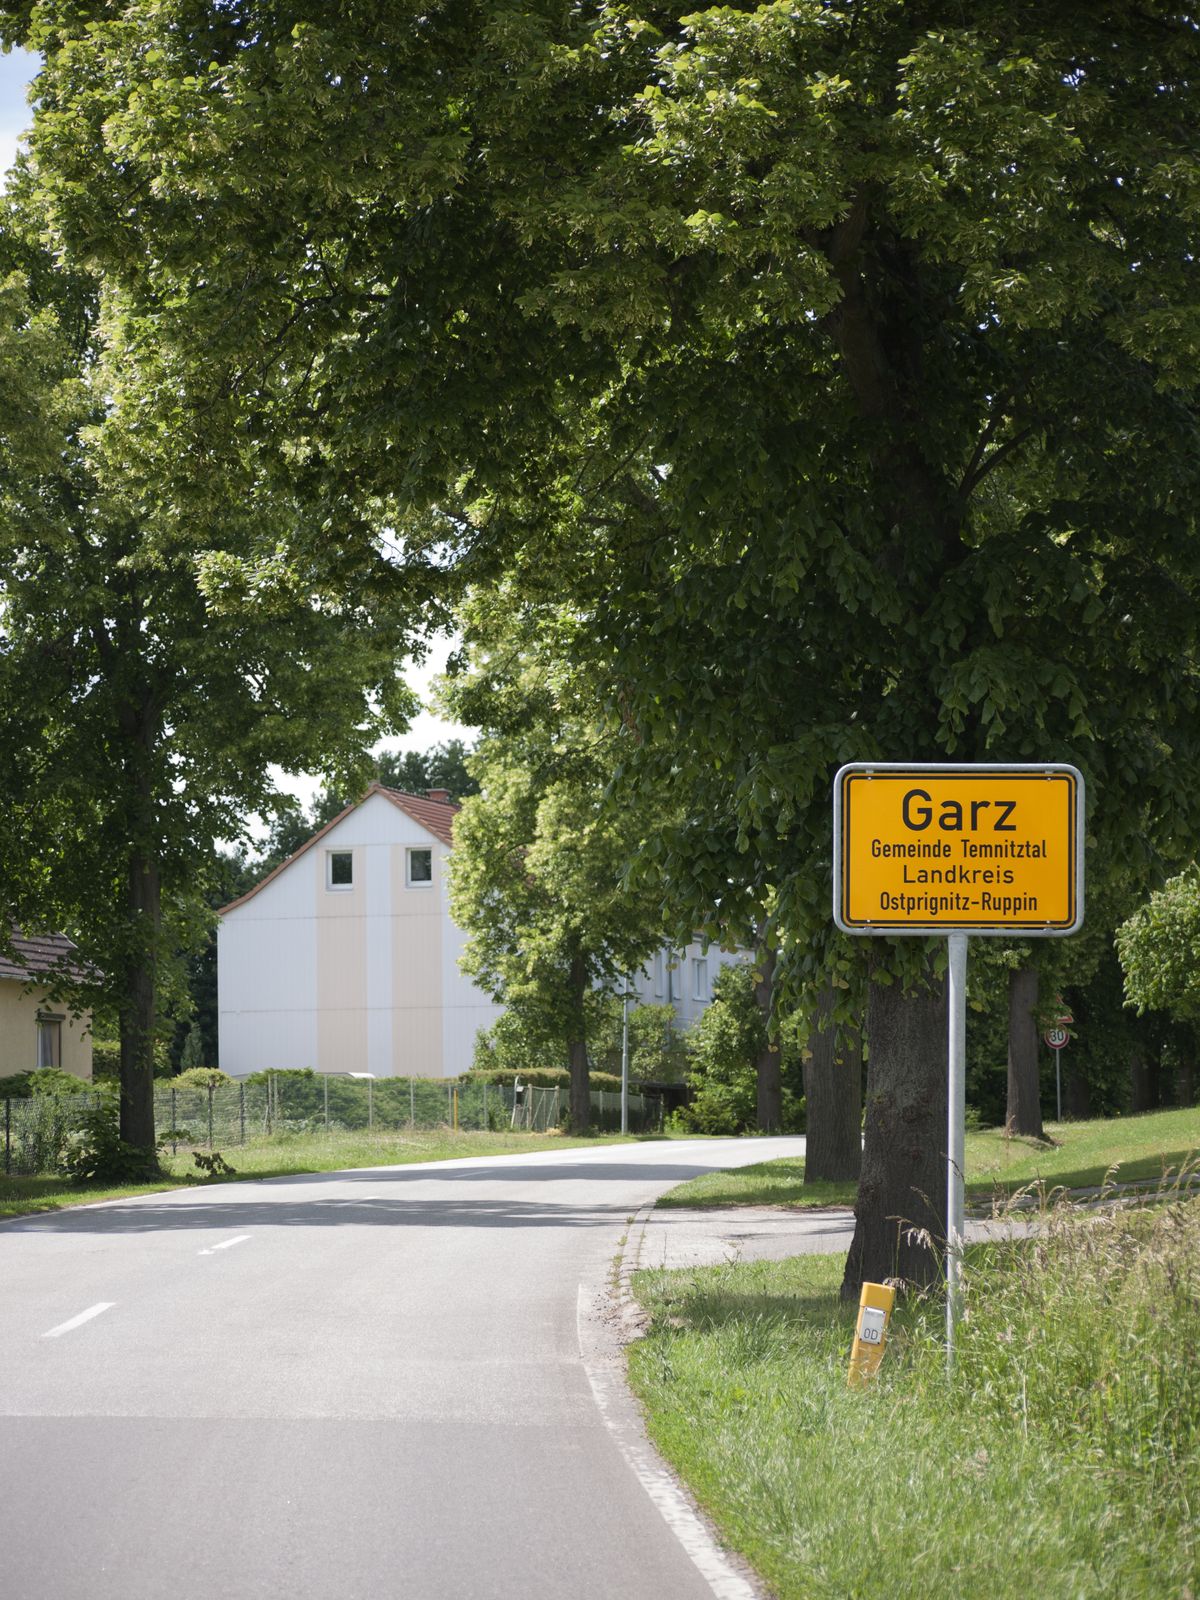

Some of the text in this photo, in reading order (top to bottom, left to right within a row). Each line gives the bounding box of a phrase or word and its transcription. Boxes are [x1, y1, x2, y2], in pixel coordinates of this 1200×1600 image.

[902, 789, 1017, 831] Garz
[871, 839, 1047, 858] Gemeinde Temnitztal
[903, 865, 1015, 884] Landkreis
[880, 891, 1038, 915] Ostprignitz-Ruppin
[1050, 1030, 1064, 1042] 30
